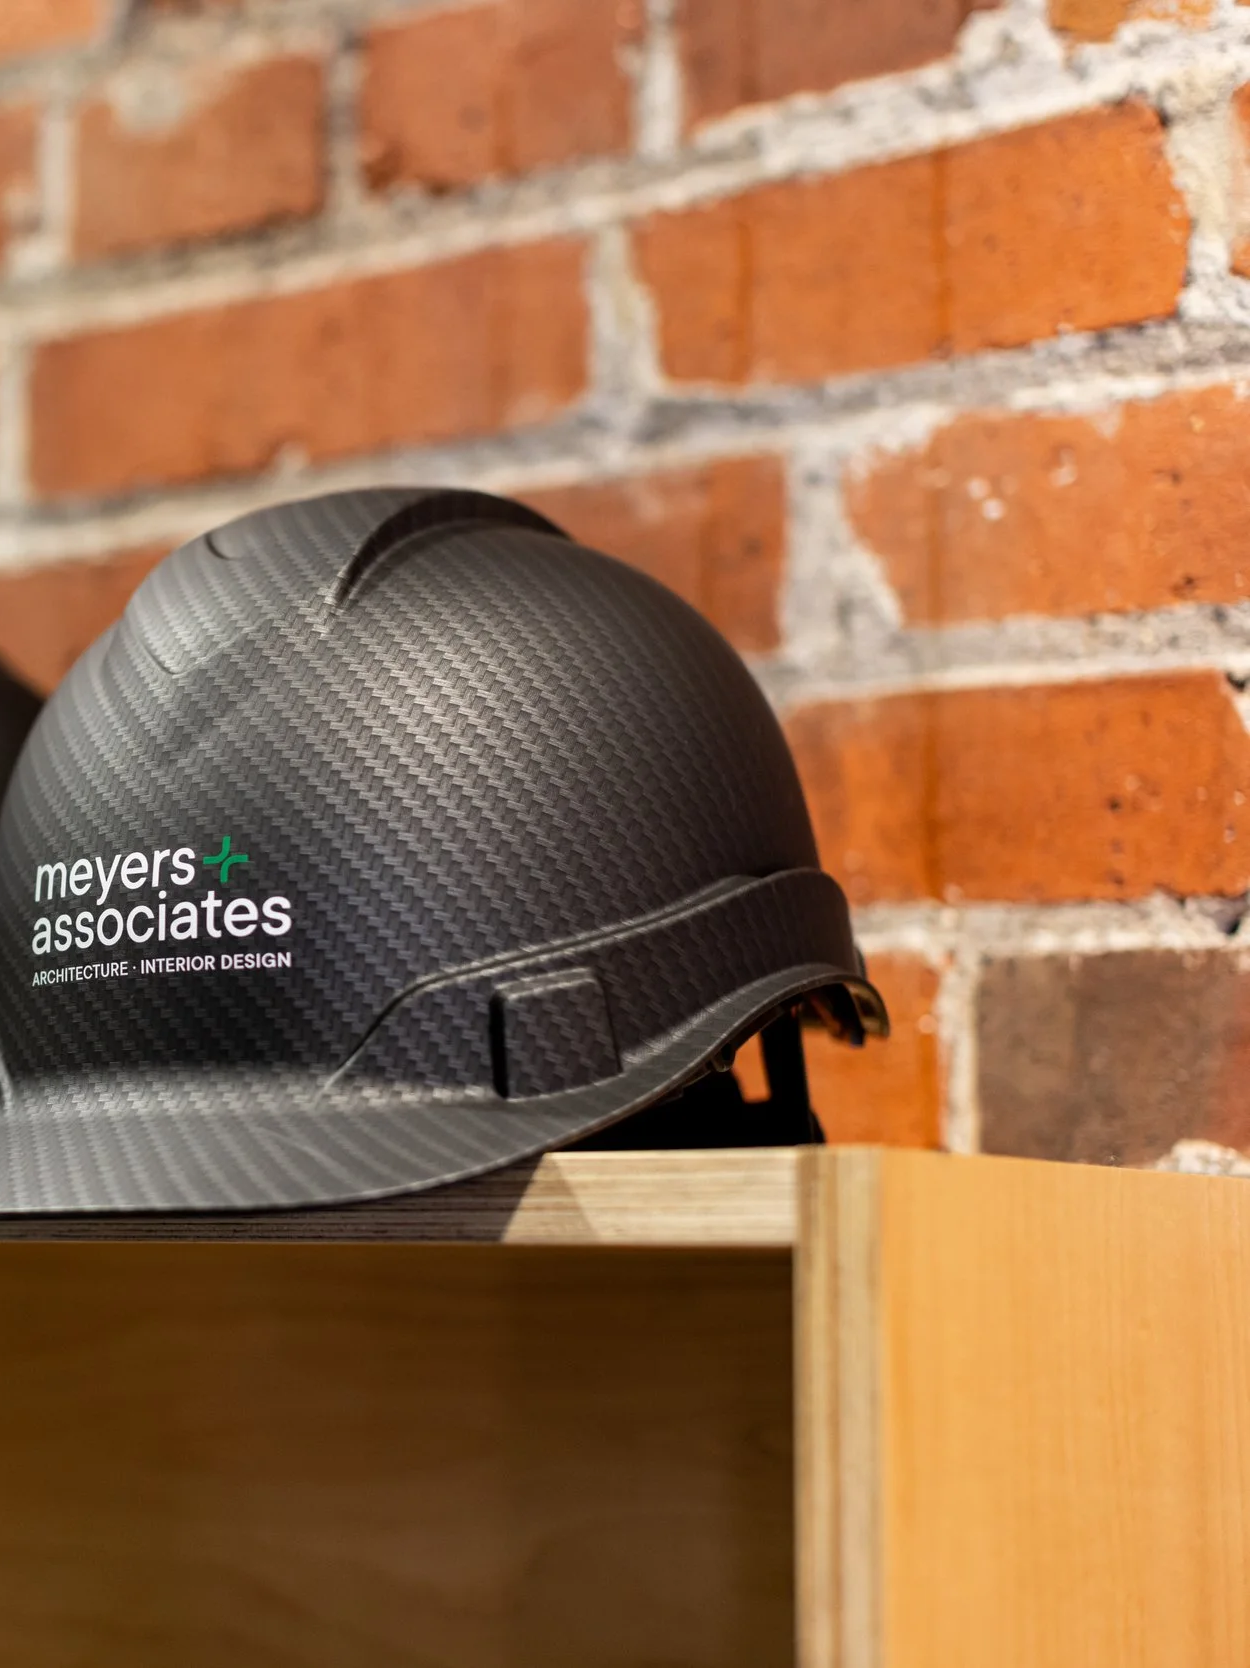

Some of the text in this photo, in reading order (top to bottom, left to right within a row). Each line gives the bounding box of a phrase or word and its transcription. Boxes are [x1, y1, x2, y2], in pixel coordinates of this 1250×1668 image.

[35, 847, 196, 905] meyers
[31, 890, 292, 955] associates
[32, 952, 292, 987] ARCHITECTURE INTERIOR DESIGN
